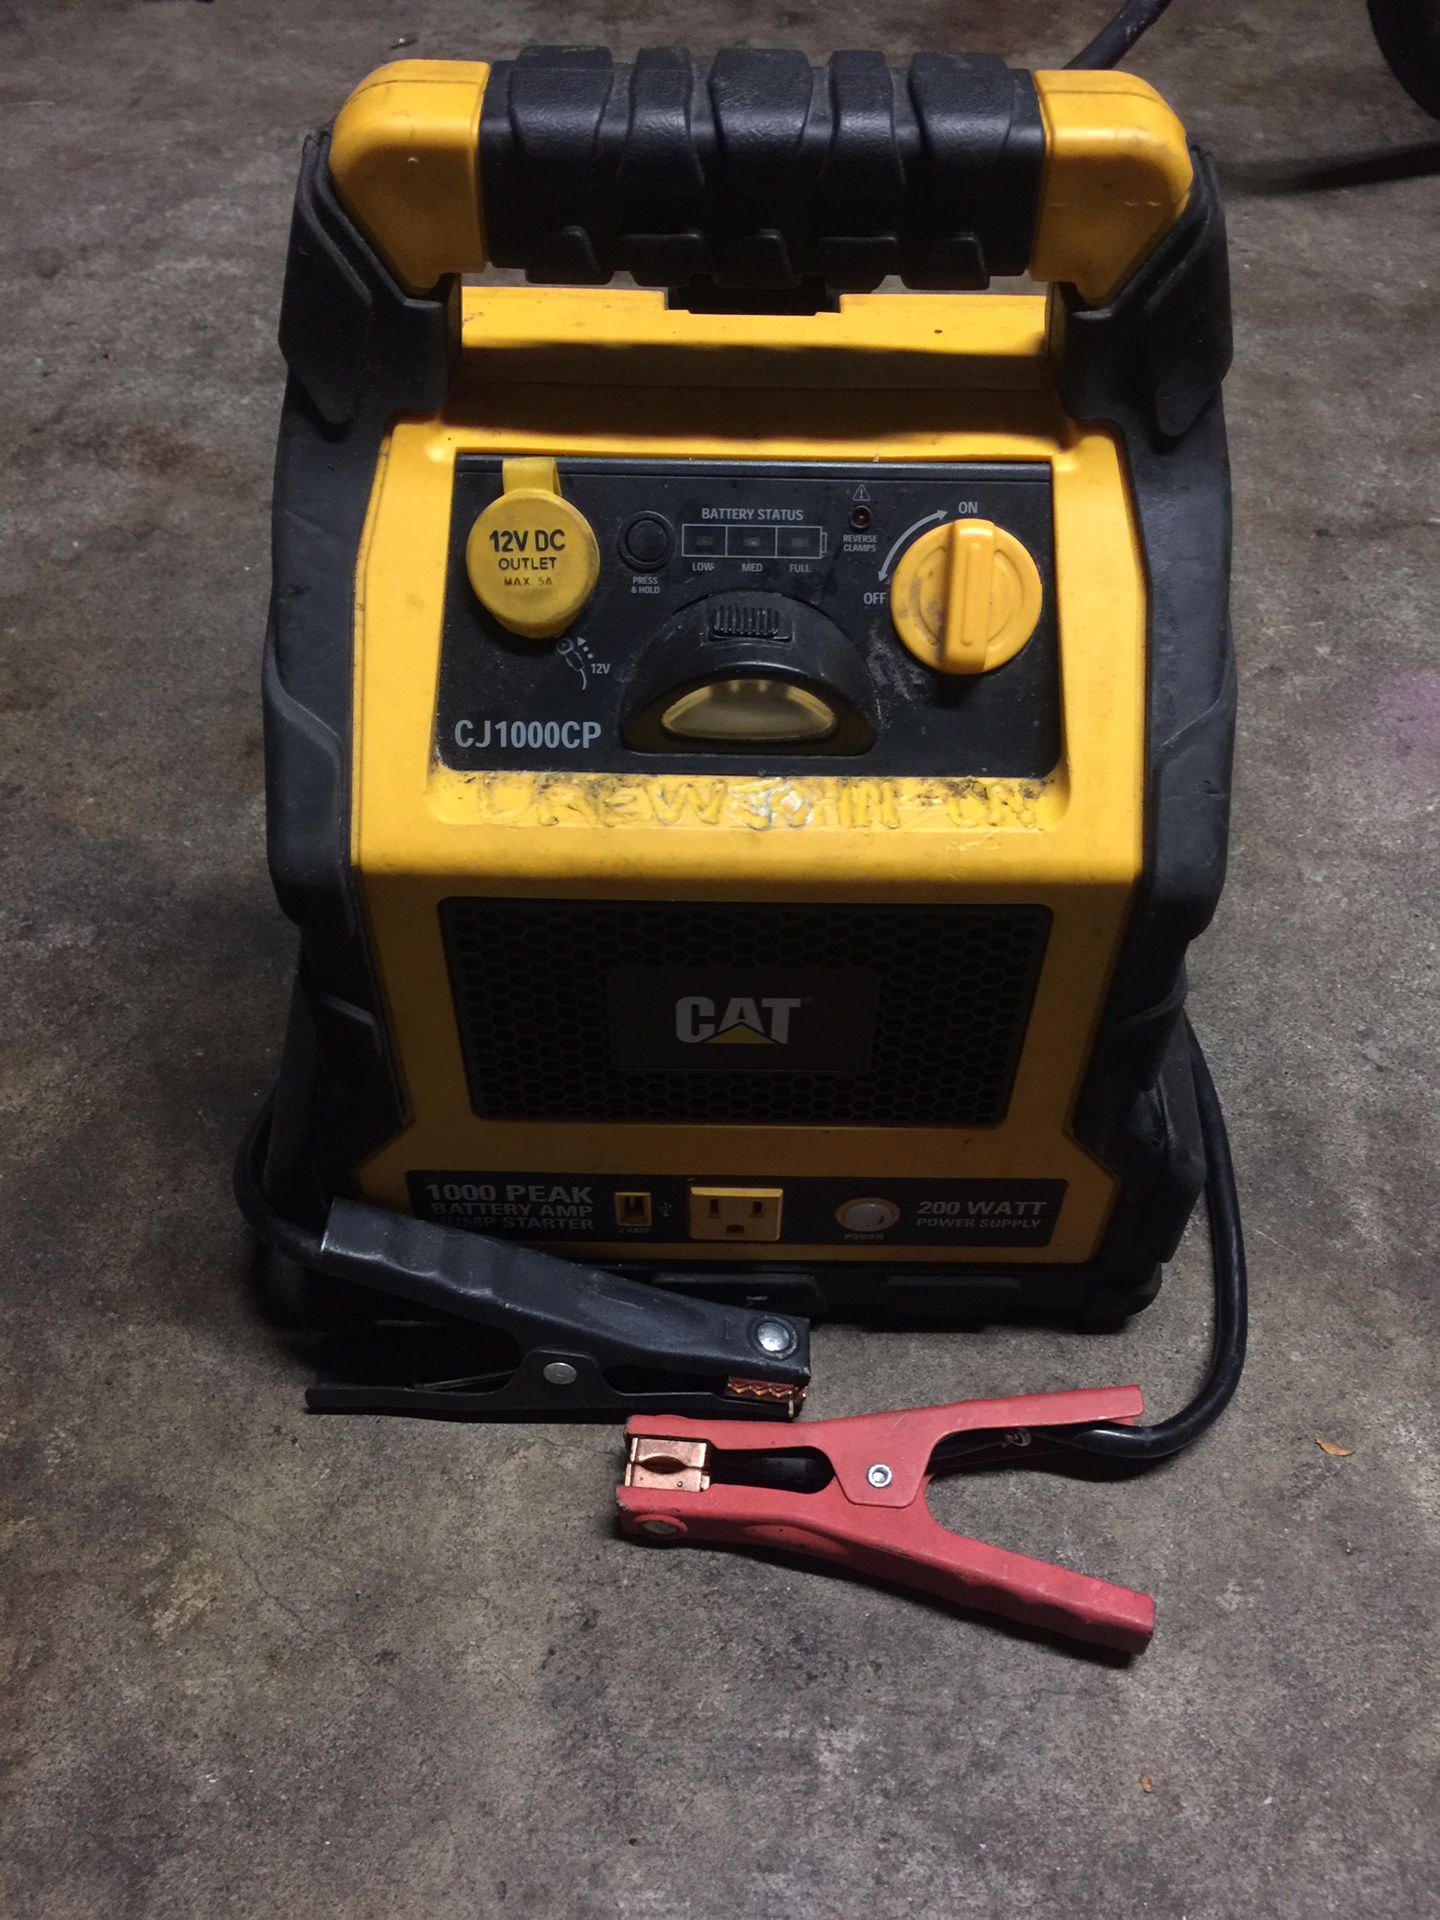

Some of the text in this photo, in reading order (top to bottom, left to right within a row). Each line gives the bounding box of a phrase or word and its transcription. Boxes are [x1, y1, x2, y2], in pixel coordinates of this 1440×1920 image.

[958, 501, 979, 515] ON
[701, 508, 804, 521] BATTERY STATUS
[490, 529, 566, 552] 12V DC
[843, 534, 878, 544] REVERSE
[843, 543, 877, 553] CLAMPS
[498, 557, 557, 571] OUTLET
[692, 562, 713, 572] LOW
[742, 563, 763, 573] MED
[789, 564, 811, 573] FULL
[504, 576, 531, 586] MAX
[632, 576, 658, 585] PRESS
[638, 585, 660, 595] HOLD
[863, 592, 887, 605] OFF
[591, 663, 611, 675] 12V
[454, 719, 602, 750] CJ1000CP
[675, 996, 801, 1045] CAT
[426, 1184, 594, 1204] 1000 PEAK
[431, 1202, 593, 1217] BATTERY AMP
[916, 1201, 1048, 1216] 200 WATT
[503, 1216, 594, 1231] STARTER
[916, 1217, 1042, 1229] POWER SUPPLY
[844, 1233, 885, 1241] POWER
